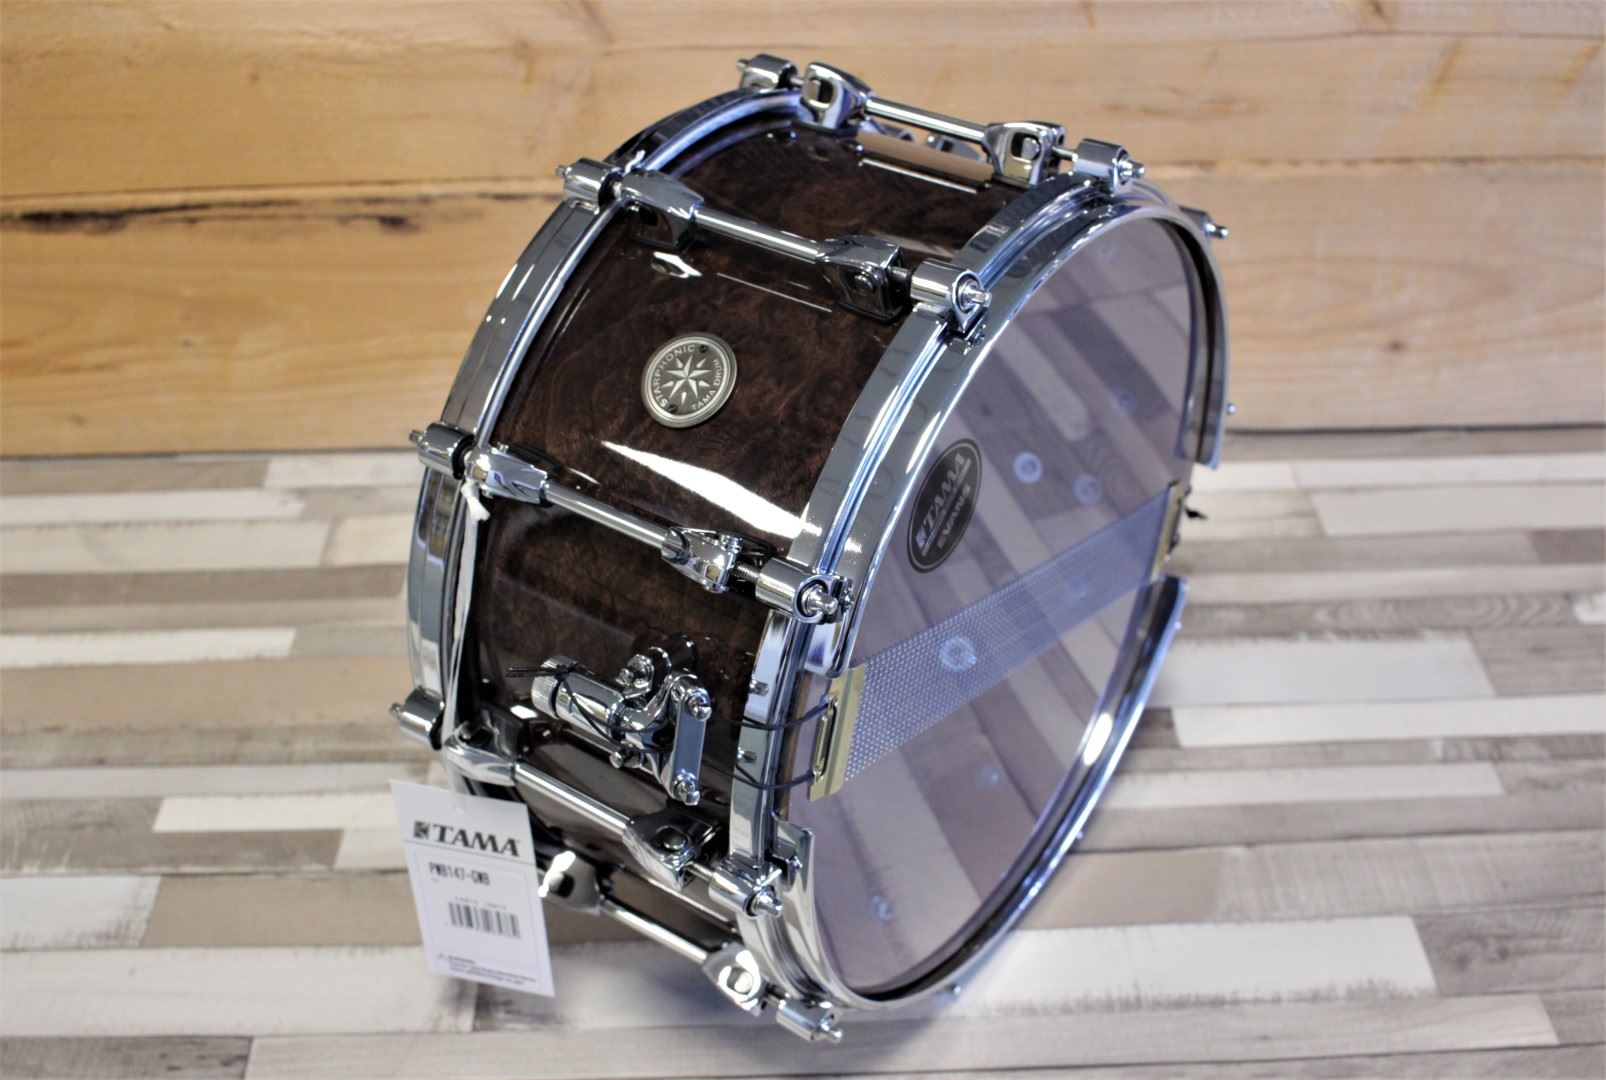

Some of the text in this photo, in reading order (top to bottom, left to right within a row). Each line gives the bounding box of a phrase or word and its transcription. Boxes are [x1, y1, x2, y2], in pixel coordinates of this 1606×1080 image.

[652, 344, 696, 408] STARPHONIC
[691, 358, 723, 411] TAMA DRUM
[921, 453, 965, 534] TAMA
[937, 483, 971, 549] EVANS
[432, 823, 521, 857] TAMA
